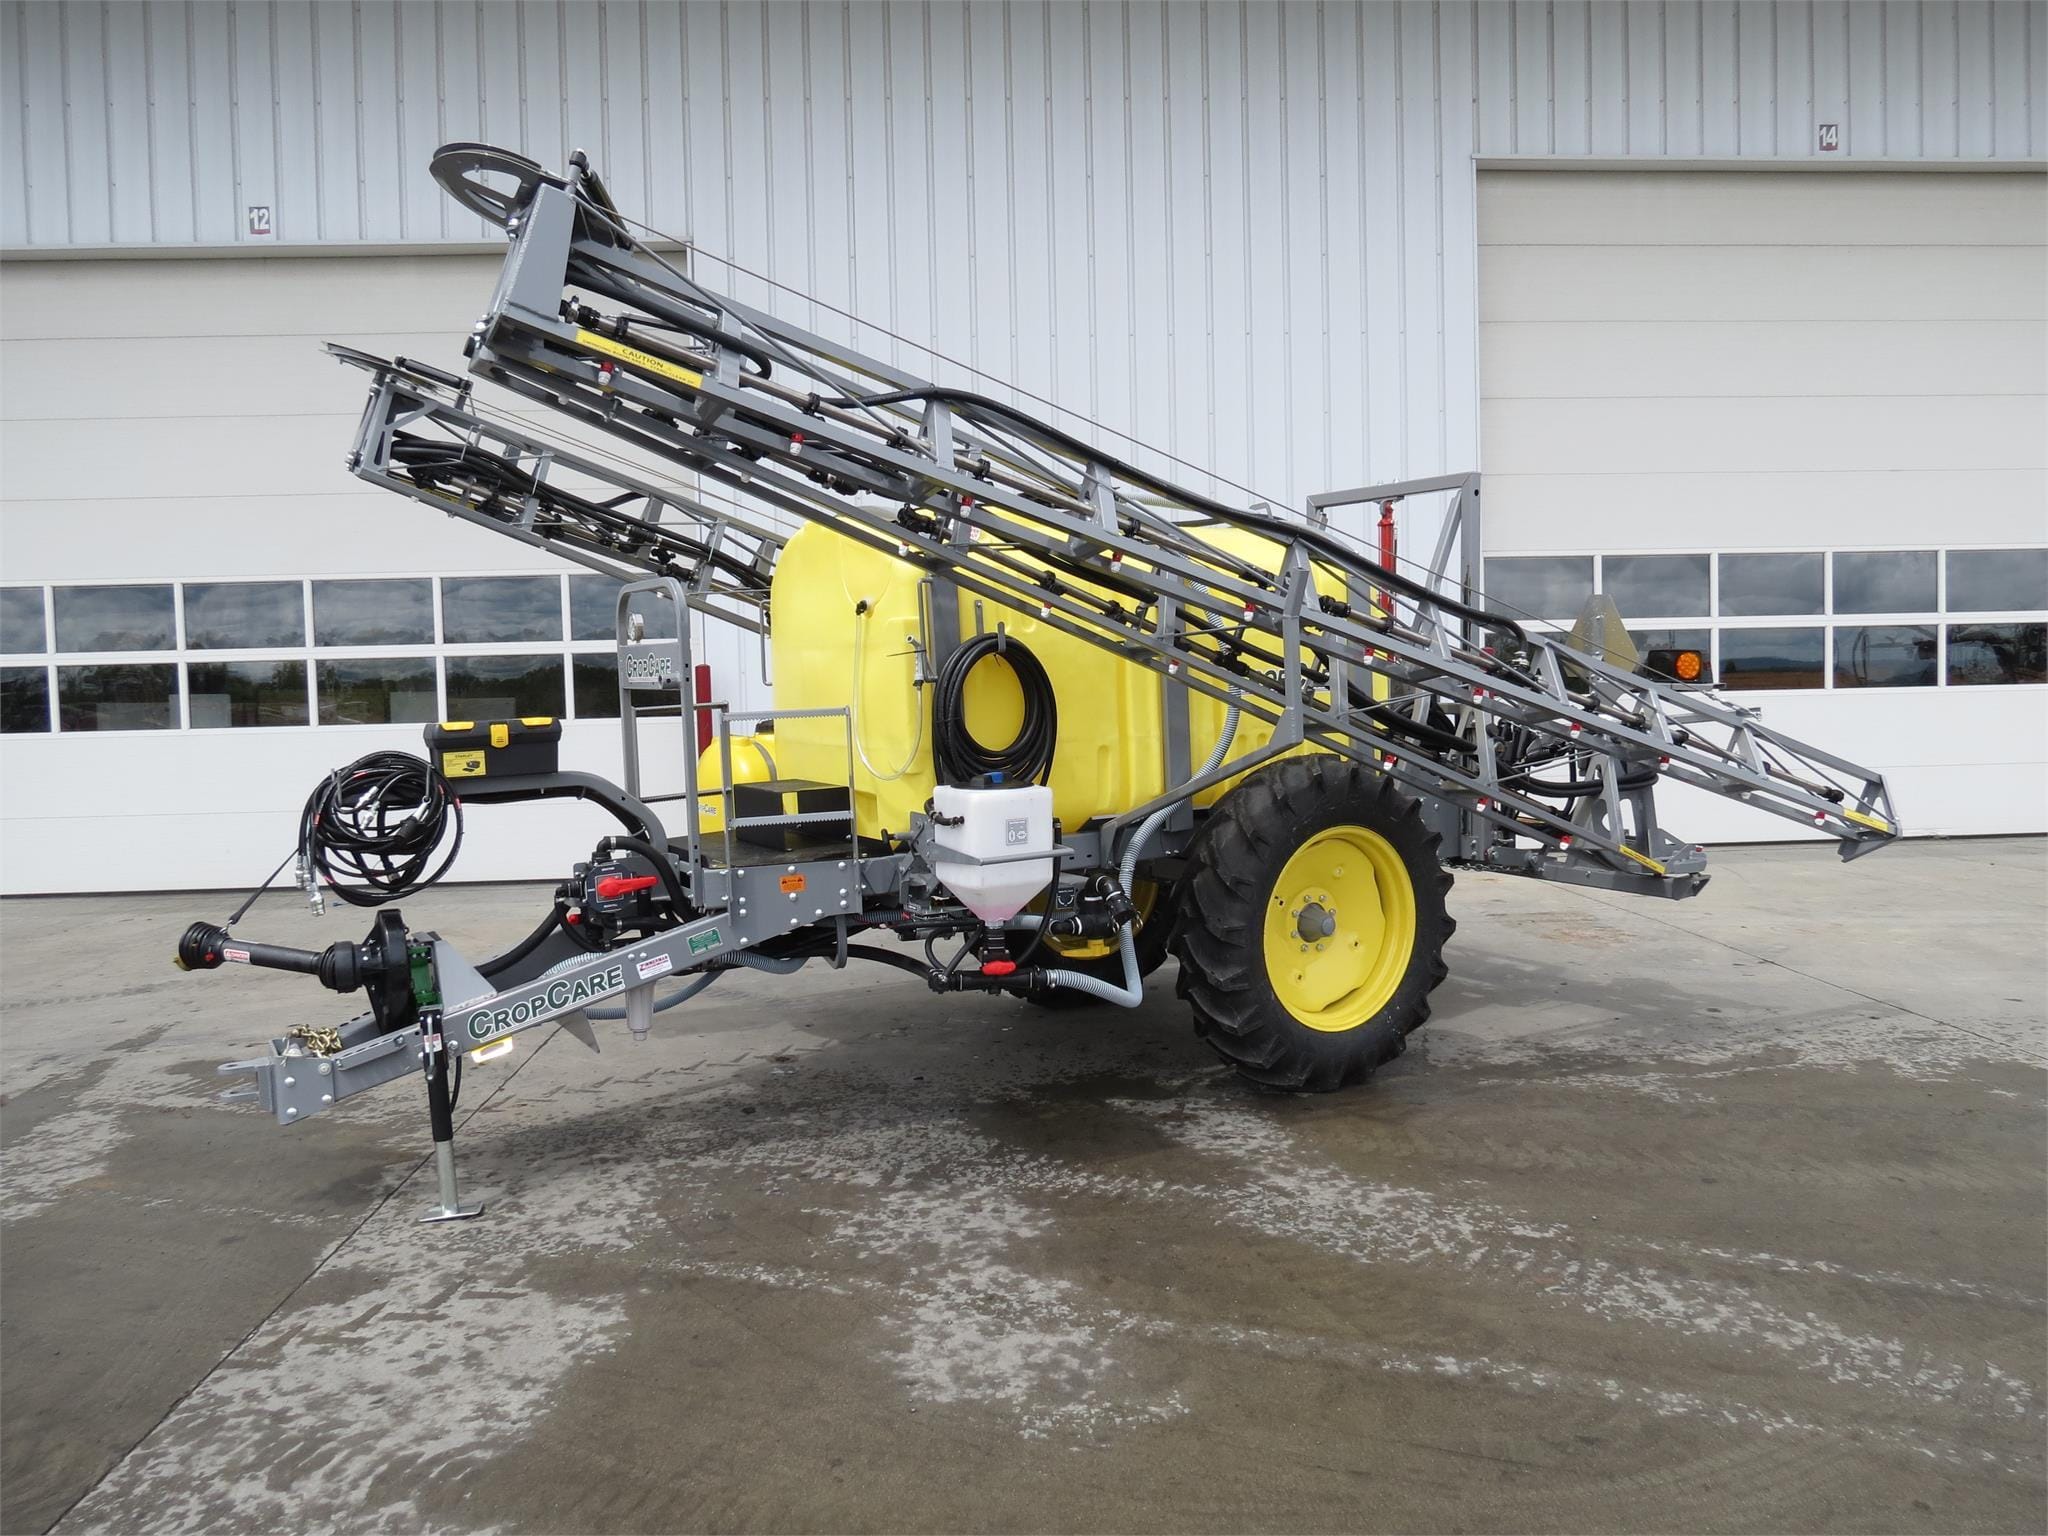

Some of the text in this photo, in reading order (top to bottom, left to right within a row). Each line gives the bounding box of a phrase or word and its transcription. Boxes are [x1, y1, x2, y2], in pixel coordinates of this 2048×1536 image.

[1820, 126, 1838, 147] 14
[250, 208, 270, 230] 12
[621, 347, 664, 368] CAUTION
